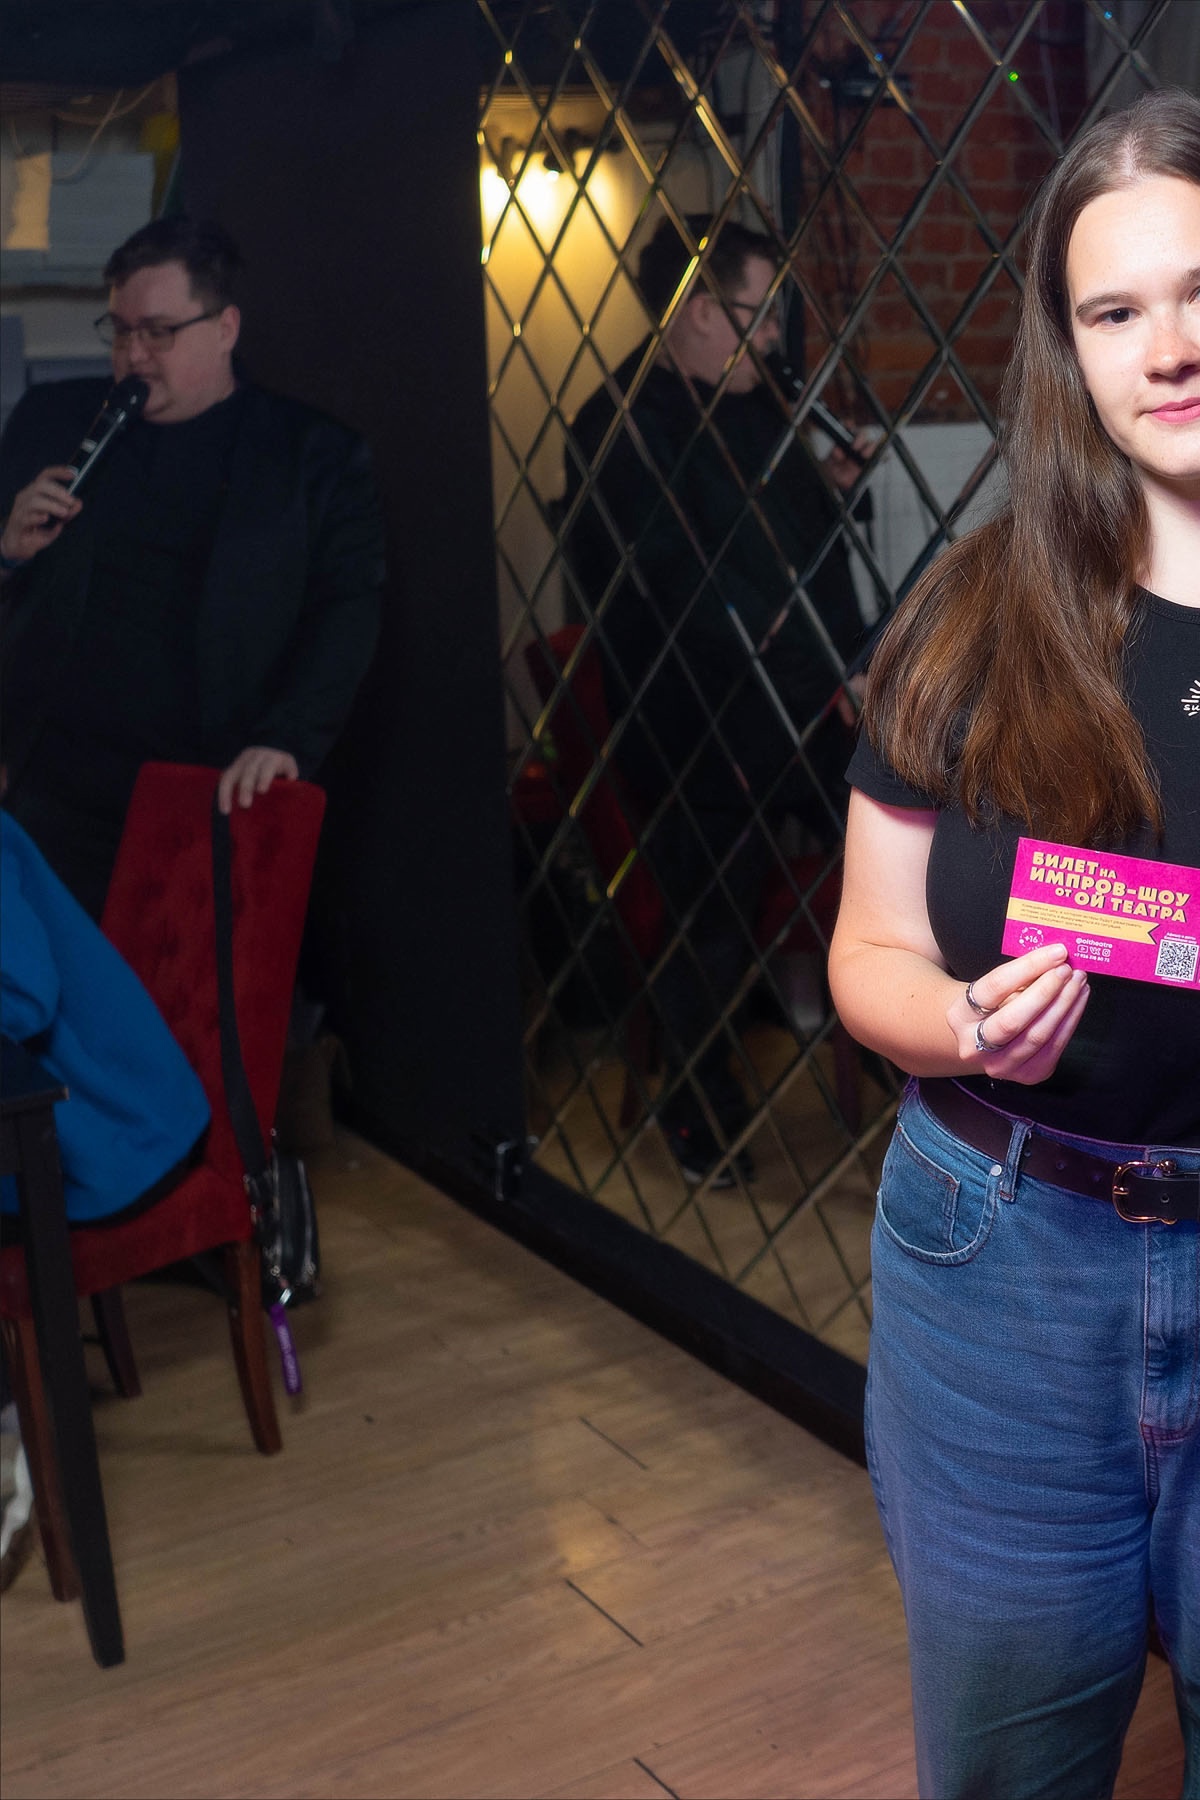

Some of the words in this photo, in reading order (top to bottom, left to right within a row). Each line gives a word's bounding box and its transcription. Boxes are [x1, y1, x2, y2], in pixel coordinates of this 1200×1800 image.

[1032, 851, 1099, 875] БИЛЕТ
[1099, 868, 1117, 879] НА
[1030, 866, 1190, 907] ИМПРОВ-ШОУ
[1055, 887, 1072, 897] ОТ
[1074, 891, 1105, 909] ОЙ
[1110, 897, 1186, 923] ТЕАТРА
[1024, 935, 1039, 944] +16
